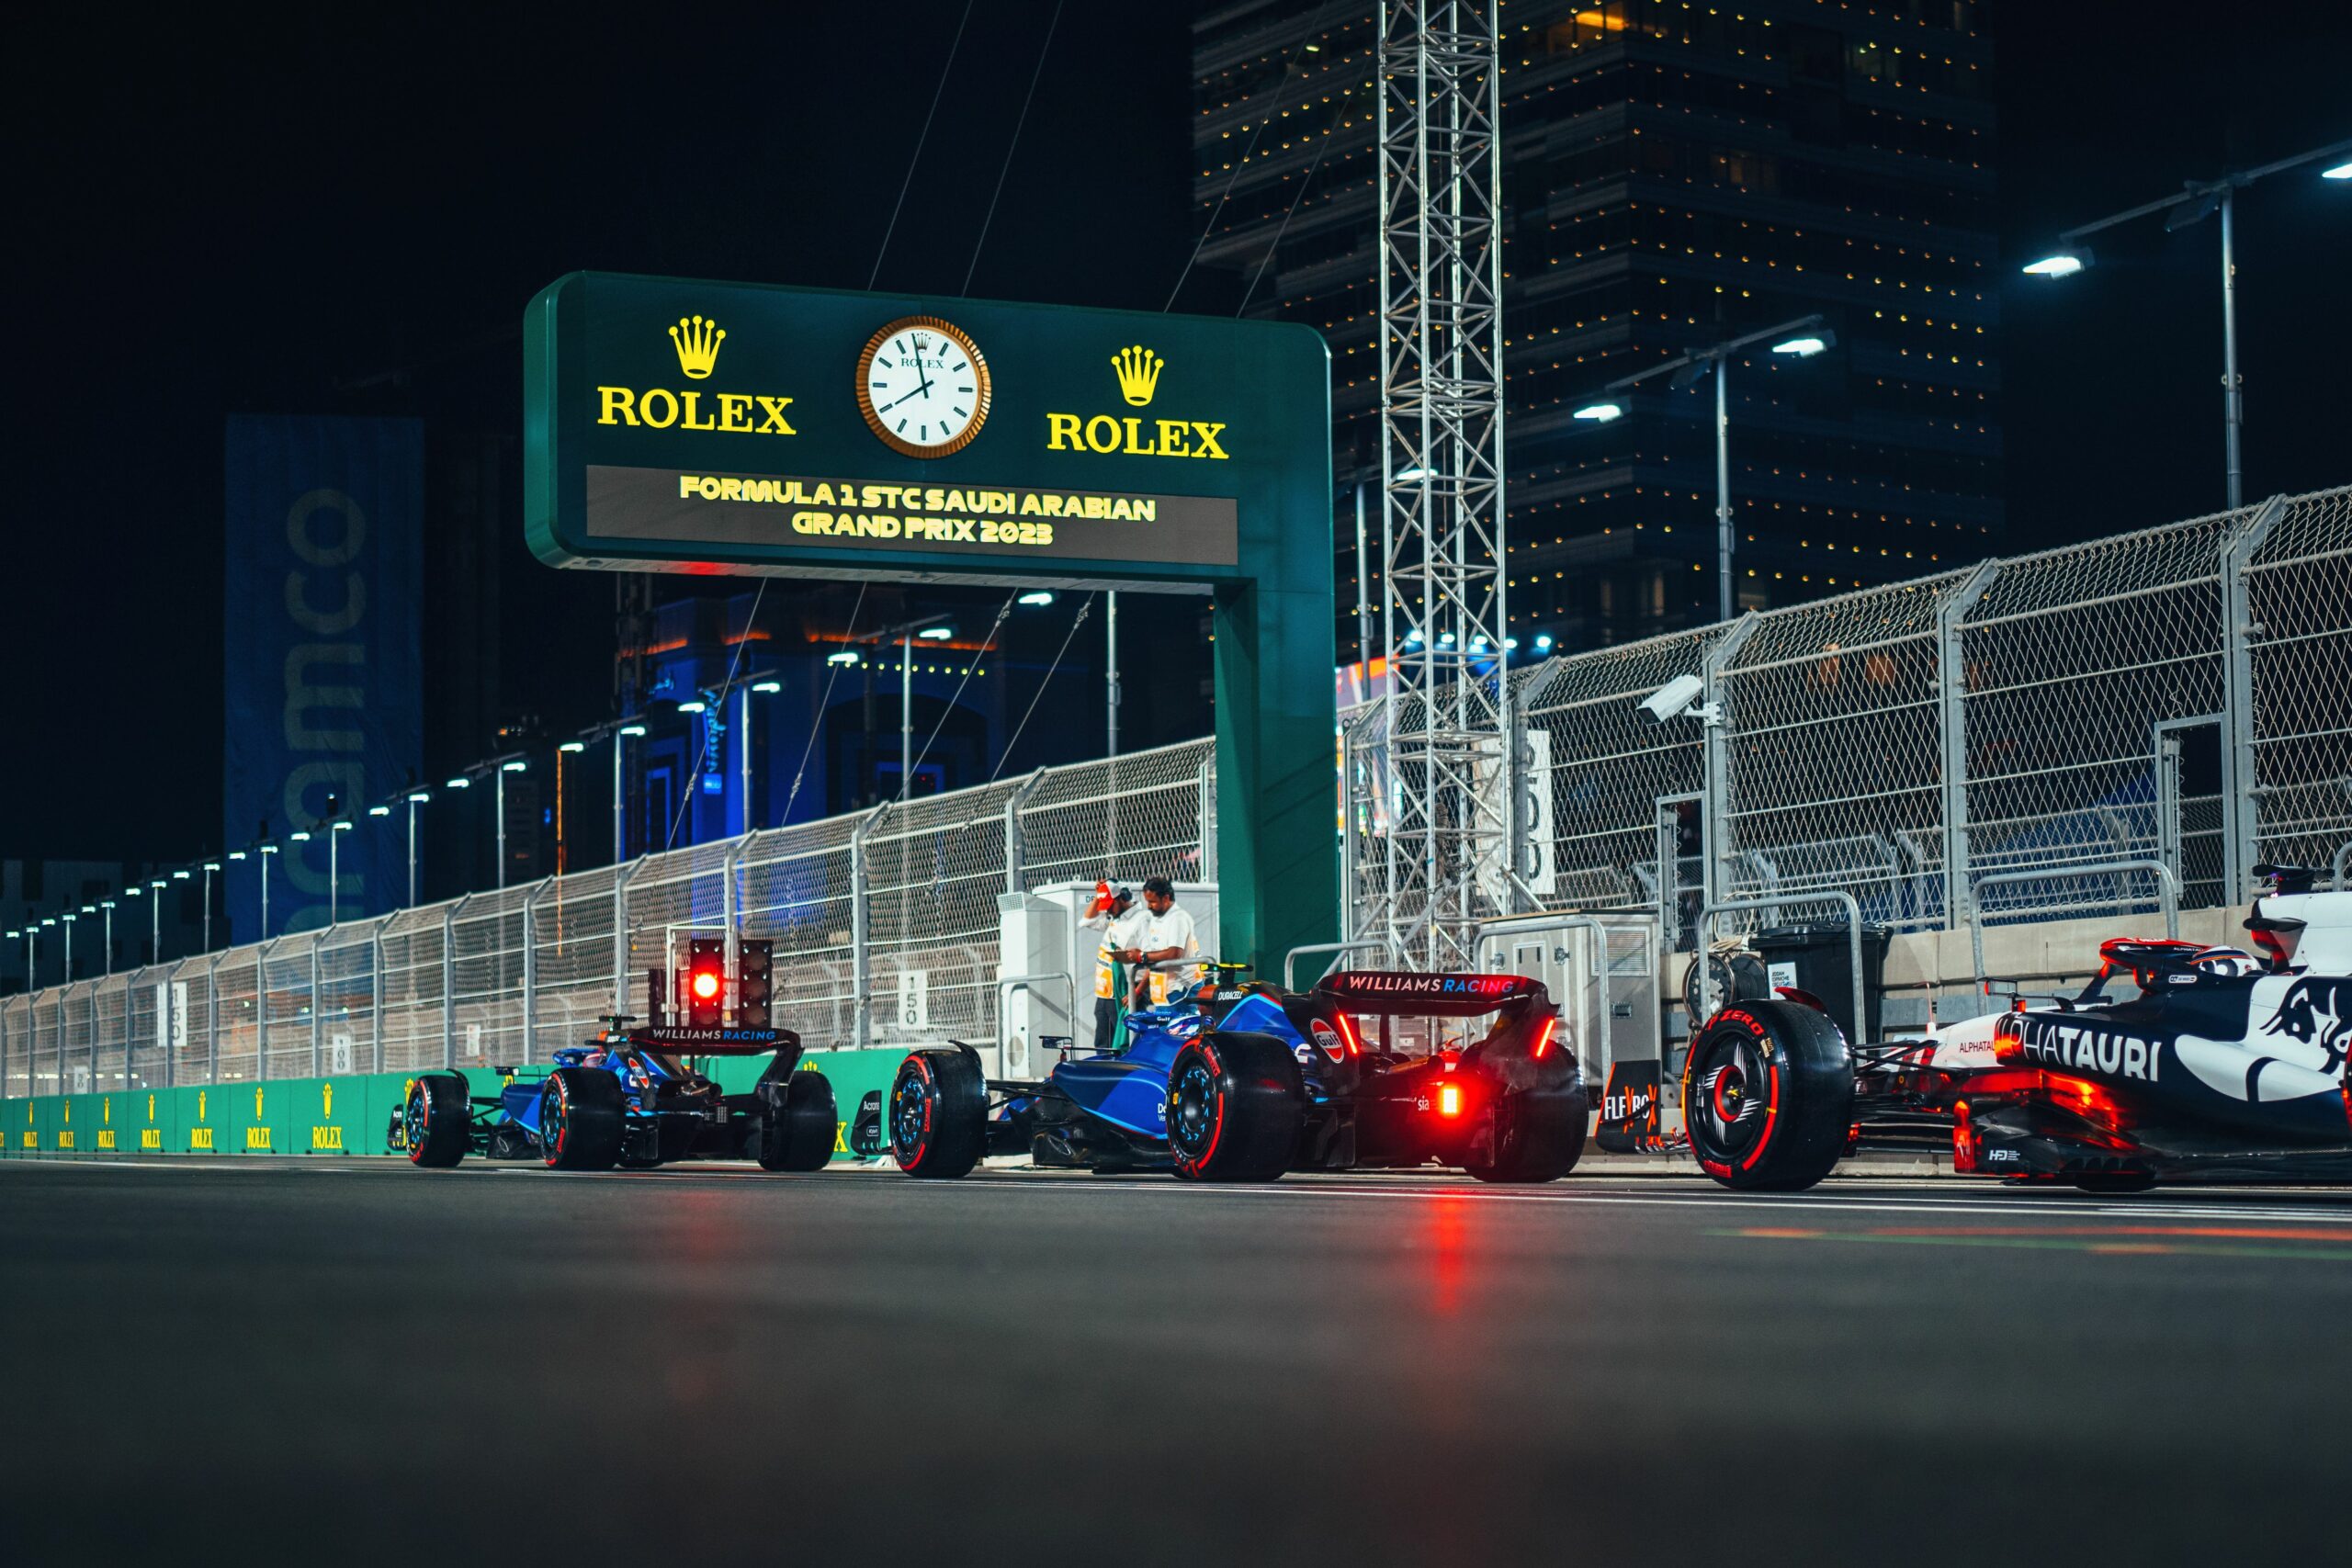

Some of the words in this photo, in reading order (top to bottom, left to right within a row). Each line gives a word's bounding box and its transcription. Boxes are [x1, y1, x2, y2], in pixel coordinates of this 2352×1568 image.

[900, 357, 944, 369] ROLEX
[597, 386, 797, 434] ROLEX
[1046, 412, 1229, 459] ROLEX
[680, 475, 836, 505] FORMULA
[841, 484, 858, 507] 1
[862, 485, 922, 511] STC
[925, 489, 1016, 514] SAUDI
[1020, 493, 1156, 522] ARABIAN
[792, 511, 901, 538] GRAND
[905, 516, 977, 542] PRIX
[979, 520, 1054, 545] 2023
[284, 488, 365, 934] ramco
[1217, 990, 1244, 1001] DURACELL
[1349, 976, 1442, 992] WILLIAMS
[1443, 978, 1514, 994] RACING
[906, 976, 917, 1025] 150
[1719, 1009, 1765, 1036] ZERO
[652, 1029, 721, 1040] WILLIAMS
[723, 1031, 776, 1040] RACING
[1316, 1033, 1340, 1047] Gulf
[191, 1128, 212, 1148] ROLEX
[247, 1127, 271, 1148] ROLEX
[312, 1126, 342, 1148] ROLEX
